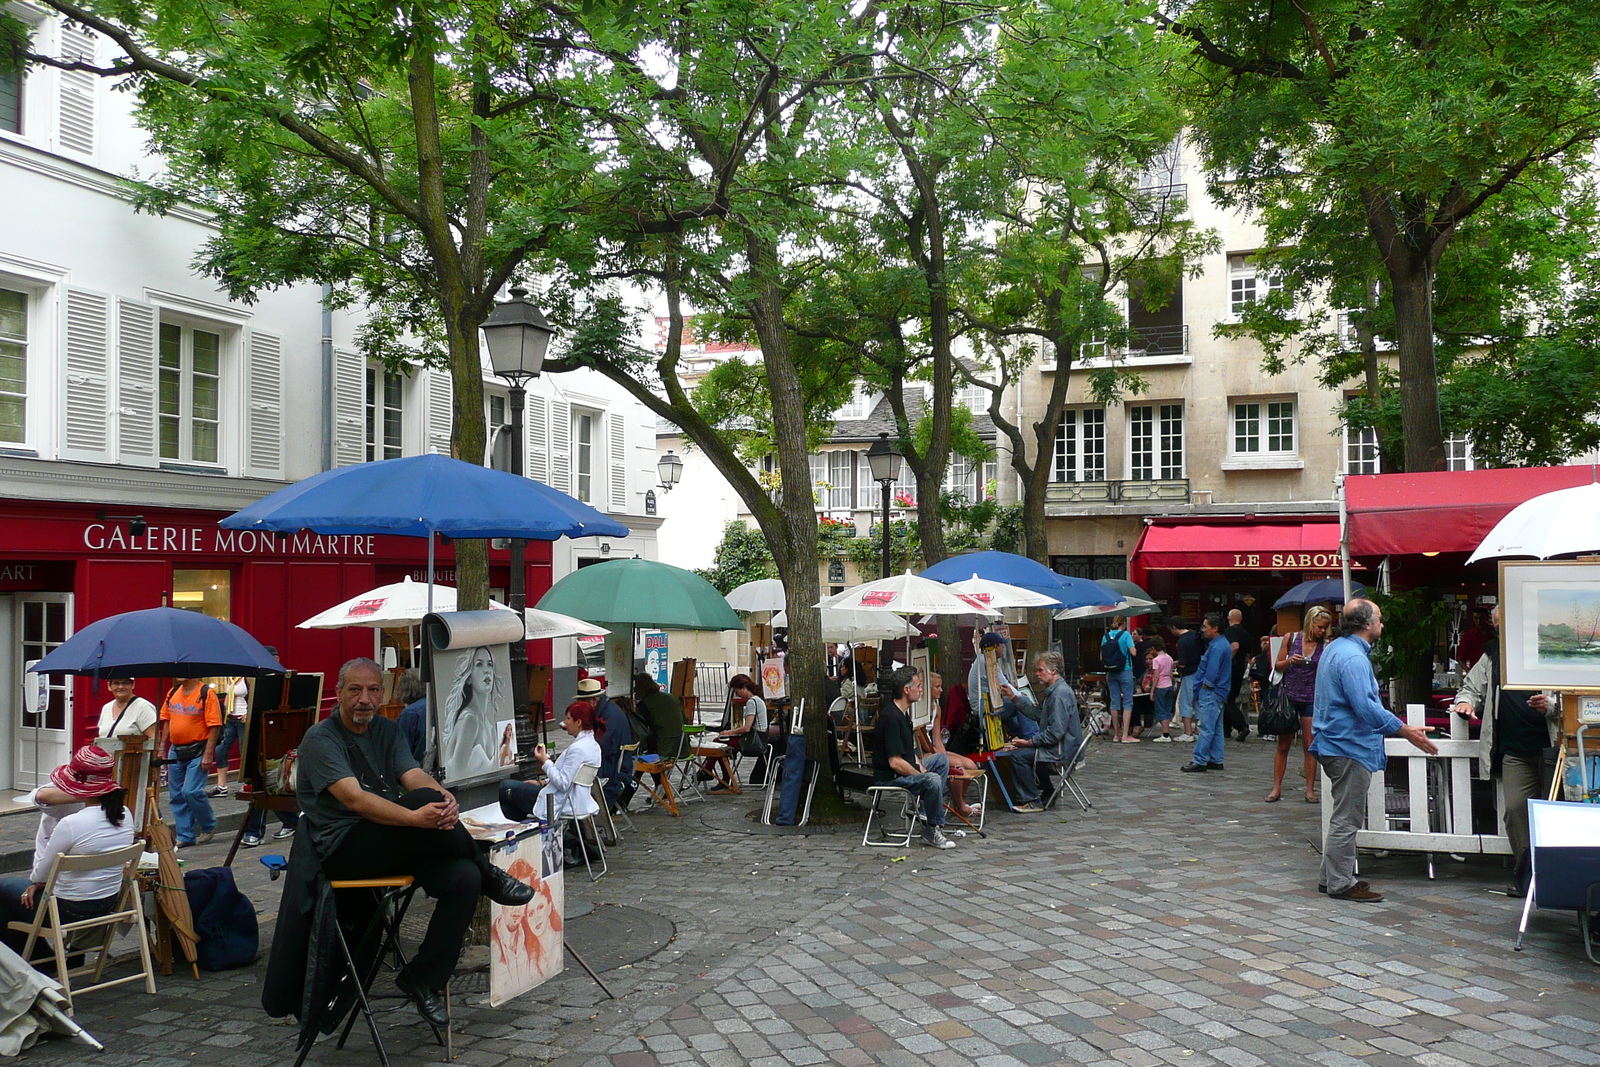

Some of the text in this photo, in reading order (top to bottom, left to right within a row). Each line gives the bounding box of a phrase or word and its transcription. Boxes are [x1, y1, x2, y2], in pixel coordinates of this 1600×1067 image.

[84, 523, 375, 555] GALERIE MONTMARTRE
[1233, 554, 1261, 567] LE
[1272, 554, 1342, 567] SABOT
[0, 564, 37, 580] ART
[413, 570, 457, 582] BIJUTE
